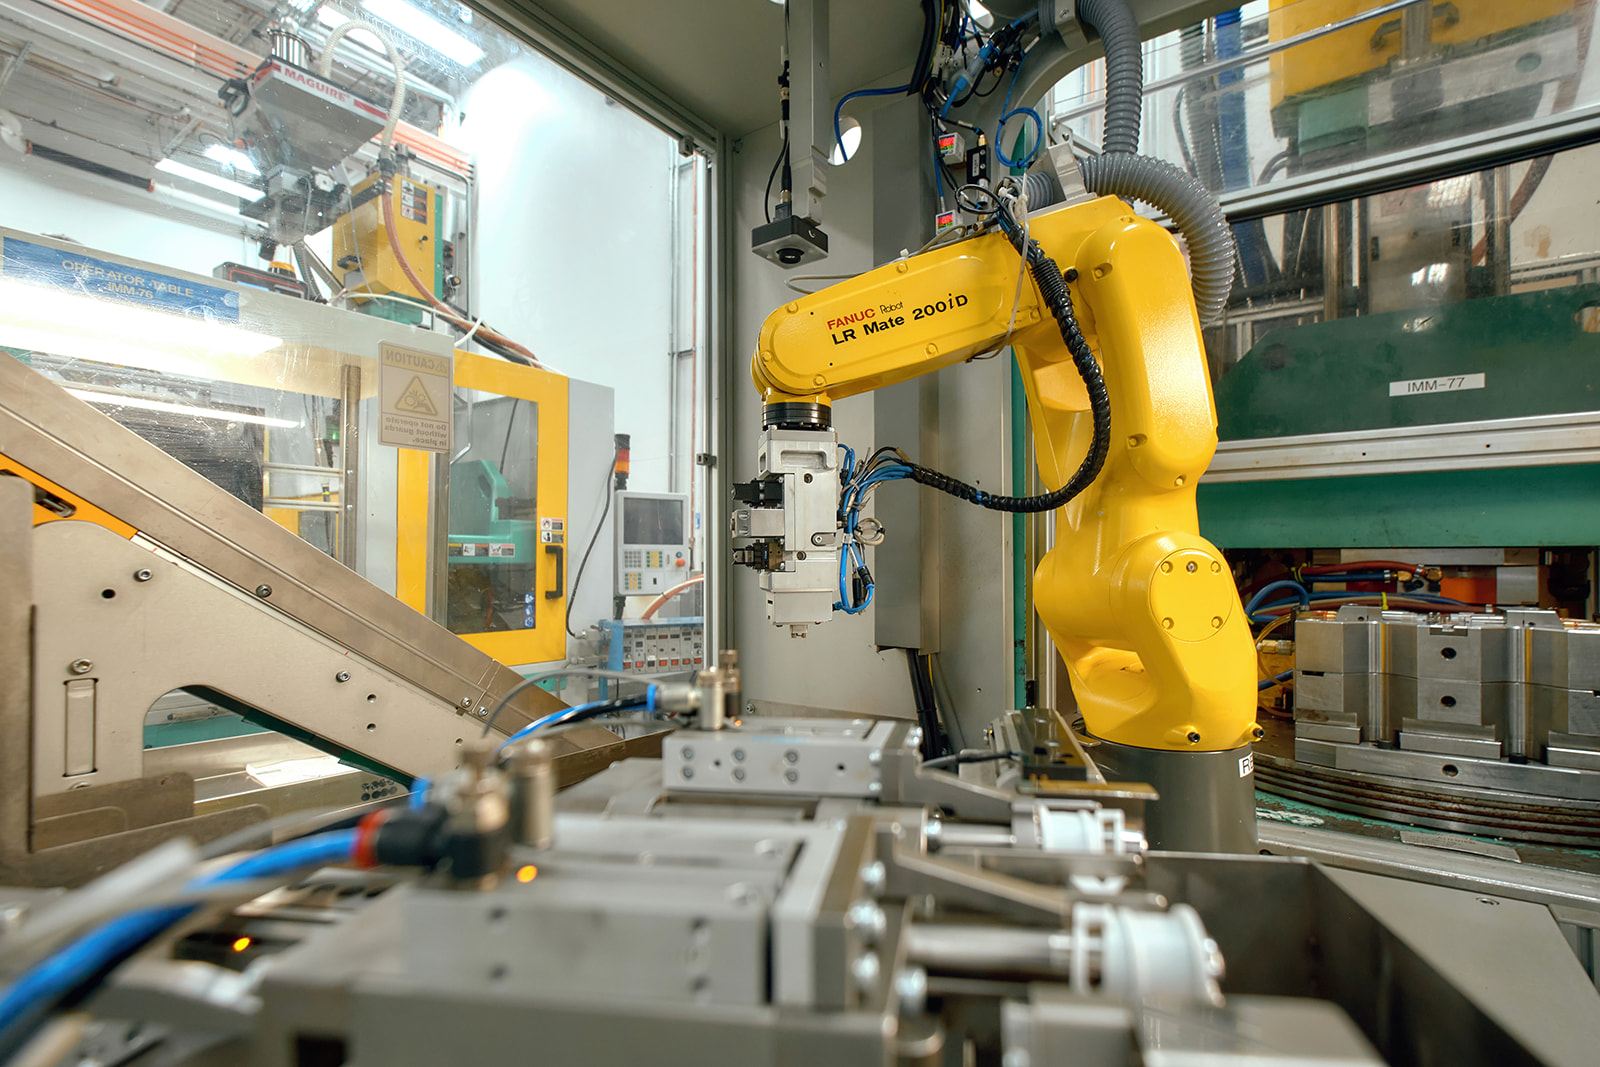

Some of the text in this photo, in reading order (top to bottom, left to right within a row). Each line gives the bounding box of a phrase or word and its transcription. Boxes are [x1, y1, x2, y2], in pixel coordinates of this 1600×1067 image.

[61, 259, 195, 298] OPERATOR TABLE
[827, 301, 904, 330] FANUC Robot
[831, 293, 968, 345] LR Mate 200iD
[1407, 377, 1465, 392] IMM-77
